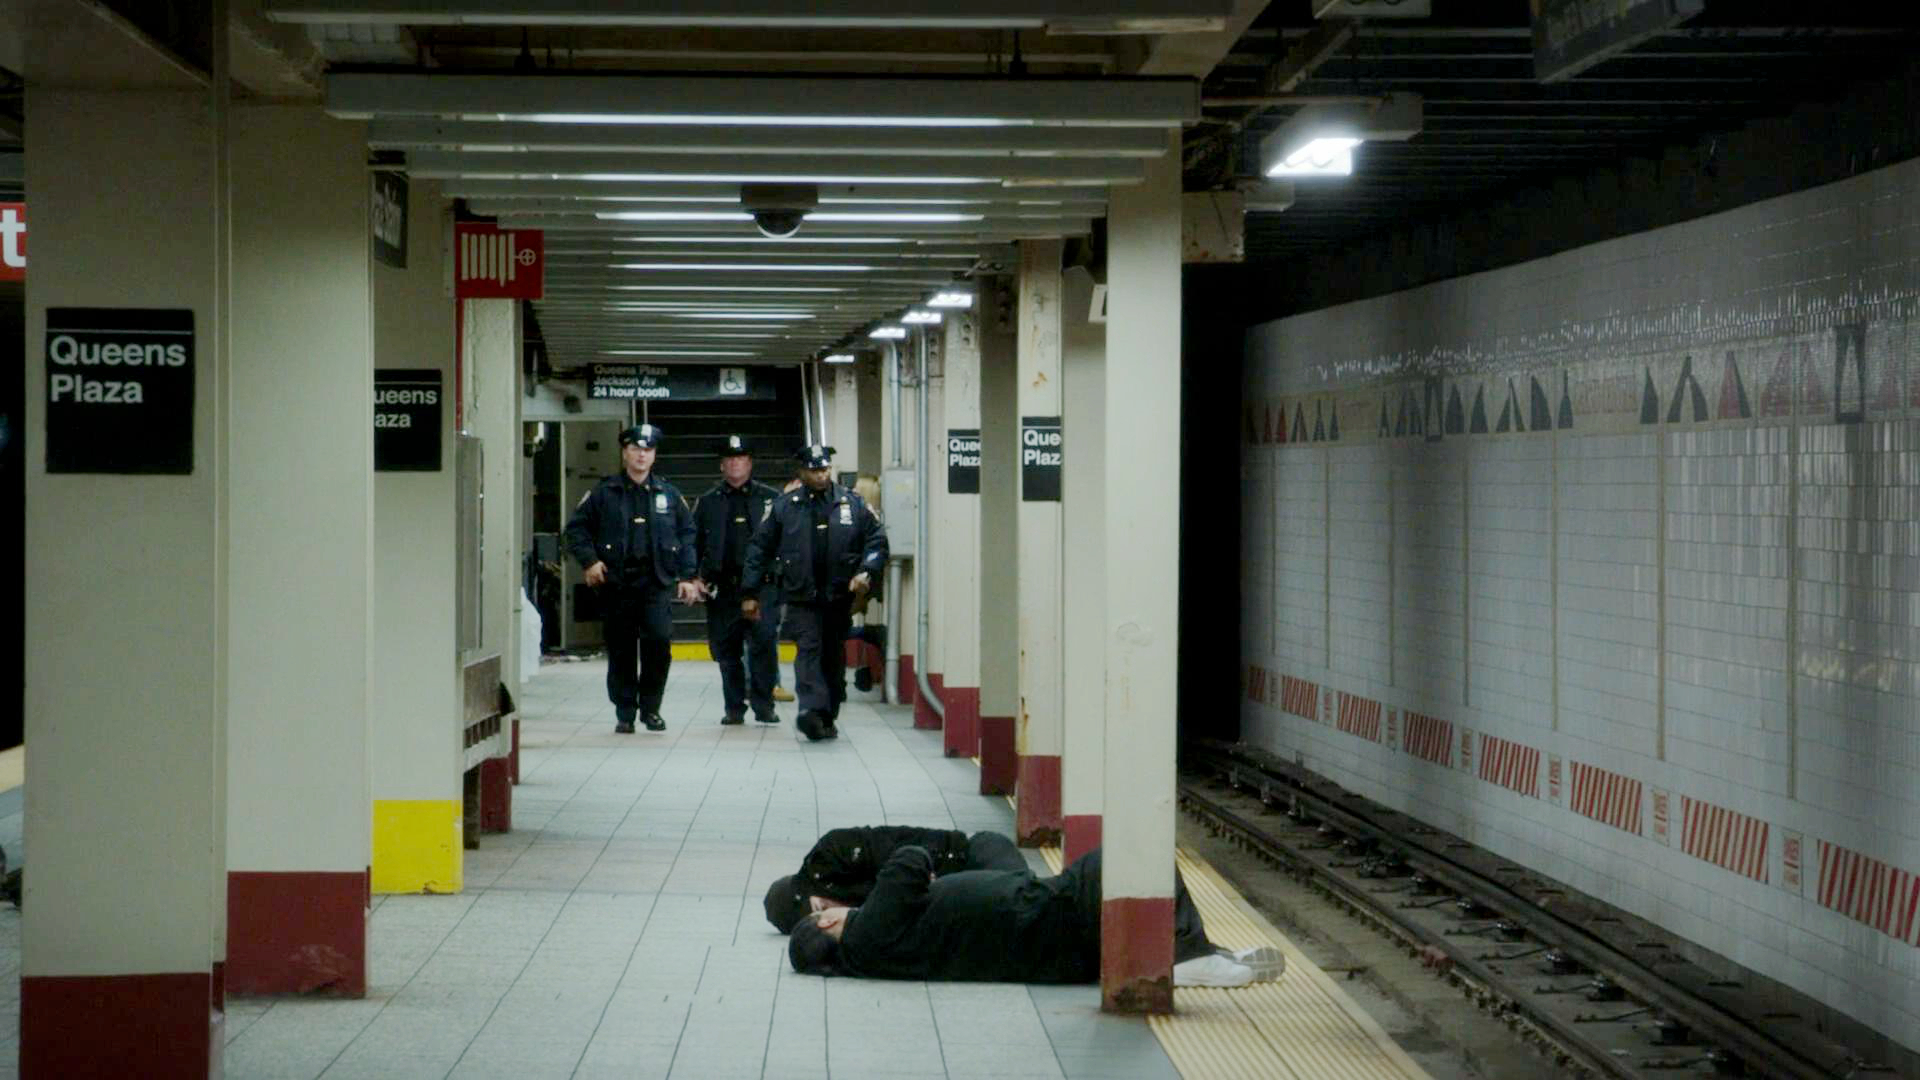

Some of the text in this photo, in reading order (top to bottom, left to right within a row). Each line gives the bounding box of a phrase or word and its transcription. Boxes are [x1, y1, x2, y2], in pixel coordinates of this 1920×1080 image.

[50, 335, 185, 366] Queens
[51, 374, 144, 403] Plaza
[593, 376, 657, 386] Jackson Av
[374, 389, 438, 405] ueens
[593, 386, 670, 398] 24 hour booth
[375, 413, 411, 428] aza
[1023, 429, 1061, 446] Que
[1023, 449, 1061, 466] Plaz
